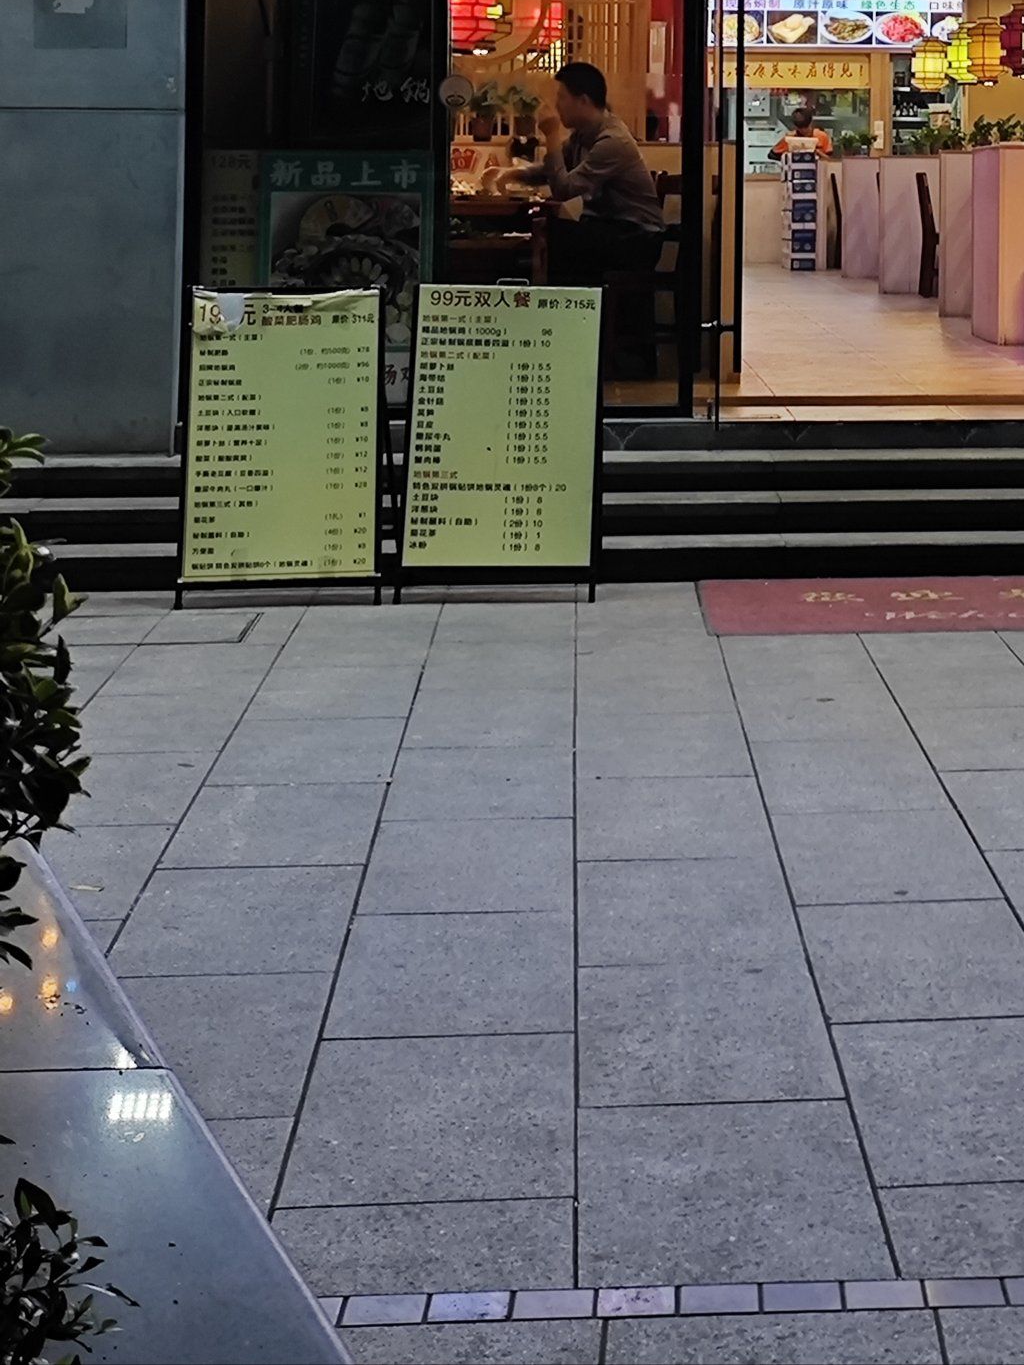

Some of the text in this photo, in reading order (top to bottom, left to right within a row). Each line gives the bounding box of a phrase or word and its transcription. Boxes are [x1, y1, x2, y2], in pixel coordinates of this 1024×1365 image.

[860, 0, 916, 11] 绿色生态
[270, 159, 420, 187] 新品上市
[430, 290, 532, 309] 99元双人餐
